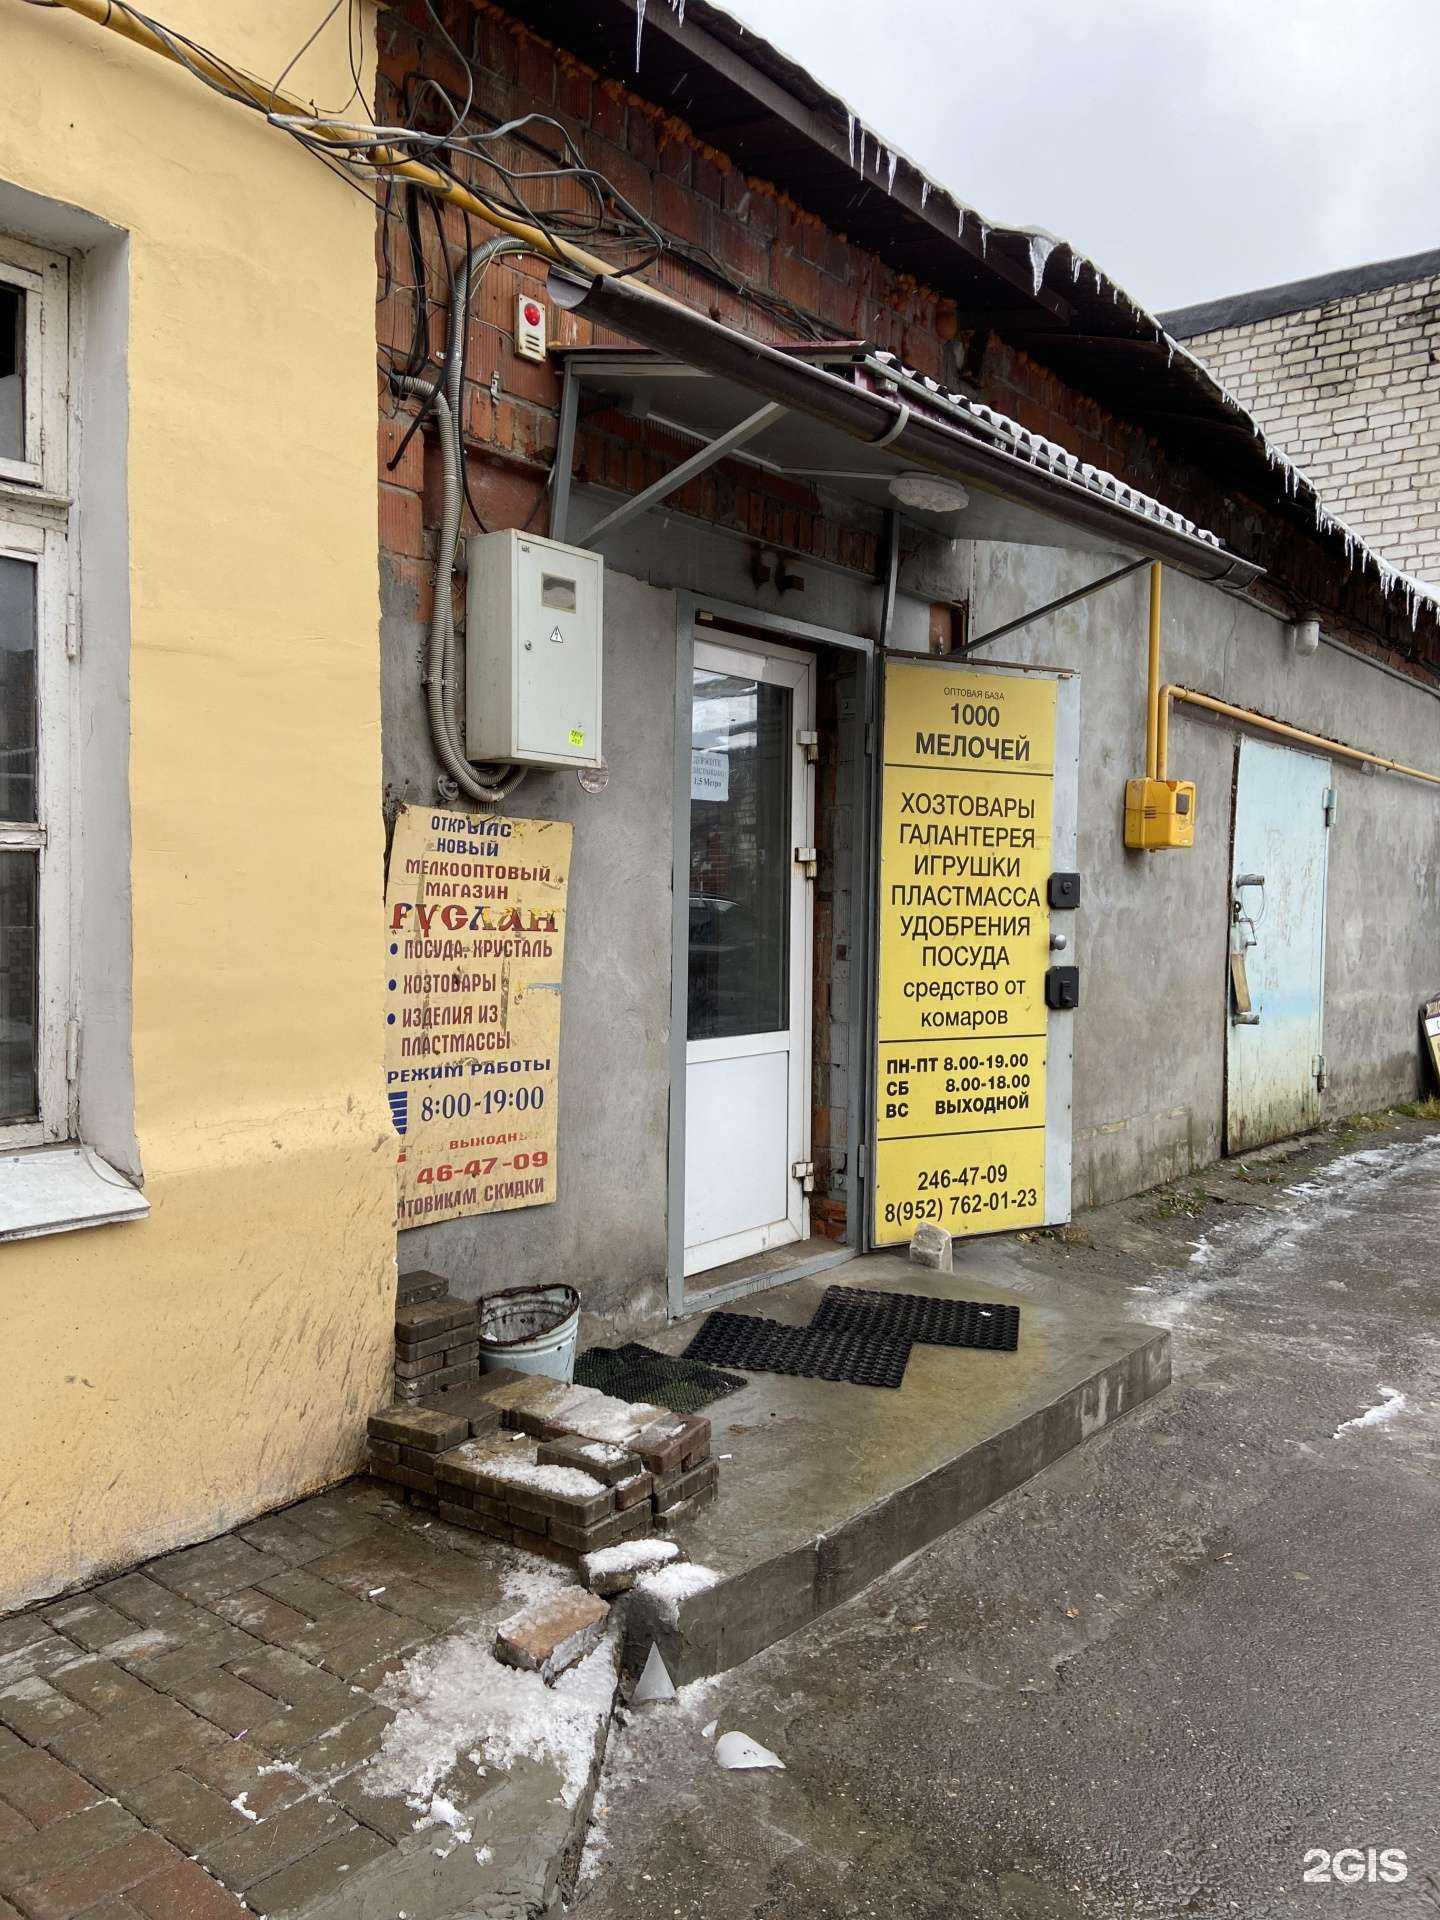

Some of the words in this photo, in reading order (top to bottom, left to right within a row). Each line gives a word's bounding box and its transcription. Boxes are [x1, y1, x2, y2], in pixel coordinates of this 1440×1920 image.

[944, 687, 983, 699] ОПТОВАЯ
[984, 690, 1005, 701] БАЗА
[951, 703, 1000, 728] 1000
[915, 732, 1030, 762] МЕЛОЧЕЙ
[900, 792, 1035, 819] ХОЗТОВАРЫ
[436, 837, 499, 857] НОВЫЙ
[899, 823, 1035, 849] ГАЛАНТЕРЕЯ
[405, 858, 551, 882] МЕЛКООПТОВЫЙ
[914, 854, 1021, 878] ИГРУШКИ
[425, 881, 509, 900] МАГАЗИН
[891, 884, 1041, 907] ПЛАСТМАССА
[389, 902, 559, 938] РУСЛАН
[900, 915, 1030, 941] УДОБРЕНИЯ
[472, 939, 553, 958] ХРУСТАЛЬ
[921, 945, 1010, 970] ПОСУДА
[403, 973, 496, 995] ХОЗТОВАРЫ
[903, 980, 999, 1002] средство
[1004, 979, 1026, 995] от
[402, 1006, 473, 1030] ИЗДЕЛИЯ
[478, 1004, 499, 1024] ИЗ
[921, 1009, 1008, 1030] комаров
[401, 1031, 511, 1057] ПЛАСТМАССЫ
[387, 1064, 464, 1084] РЕЖИМ
[470, 1058, 551, 1076] РАБОТЫ
[886, 1057, 938, 1075] ПН-ПТ
[943, 1053, 1029, 1072] 8.00-19.00
[886, 1080, 909, 1096] СБ
[945, 1074, 1031, 1093] 8.00-18.00
[421, 1086, 544, 1122] 8:00-19:00
[885, 1102, 909, 1119] ВС
[935, 1091, 1030, 1115] ВЫХОДНОЙ
[416, 1150, 549, 1185] 46-47-09
[917, 1164, 1008, 1191] 246-47-09
[396, 1187, 476, 1219] ПТОВИКАМ
[484, 1177, 545, 1202] СКИДКИ
[884, 1198, 943, 1226] 8(952)
[950, 1188, 1037, 1216] 762-01-23
